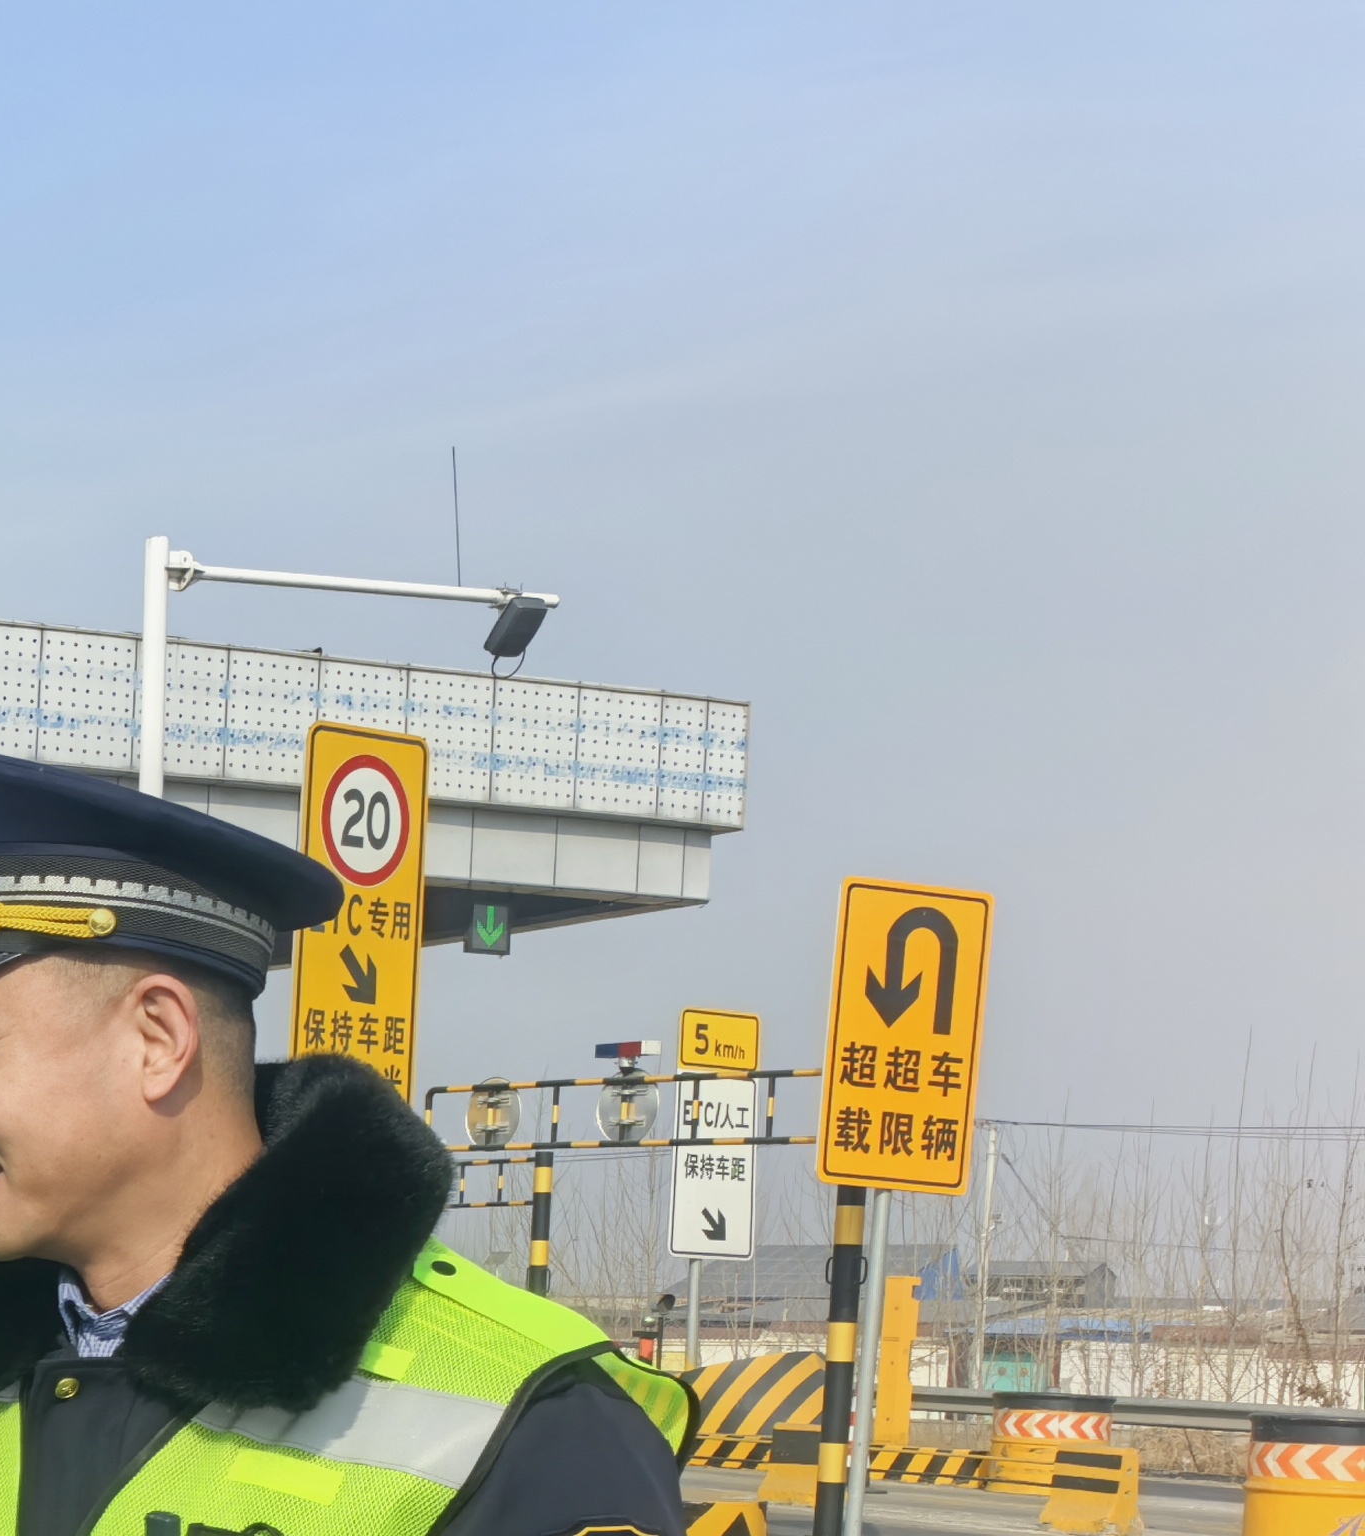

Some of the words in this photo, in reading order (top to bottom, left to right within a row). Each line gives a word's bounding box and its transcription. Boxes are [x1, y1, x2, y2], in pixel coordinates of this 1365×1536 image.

[340, 788, 391, 851] 20
[310, 893, 411, 941] C专用
[303, 1007, 406, 1055] 保持车距
[694, 1023, 709, 1055] 5
[714, 1039, 746, 1060] km/h
[684, 1152, 747, 1182] 保持车距
